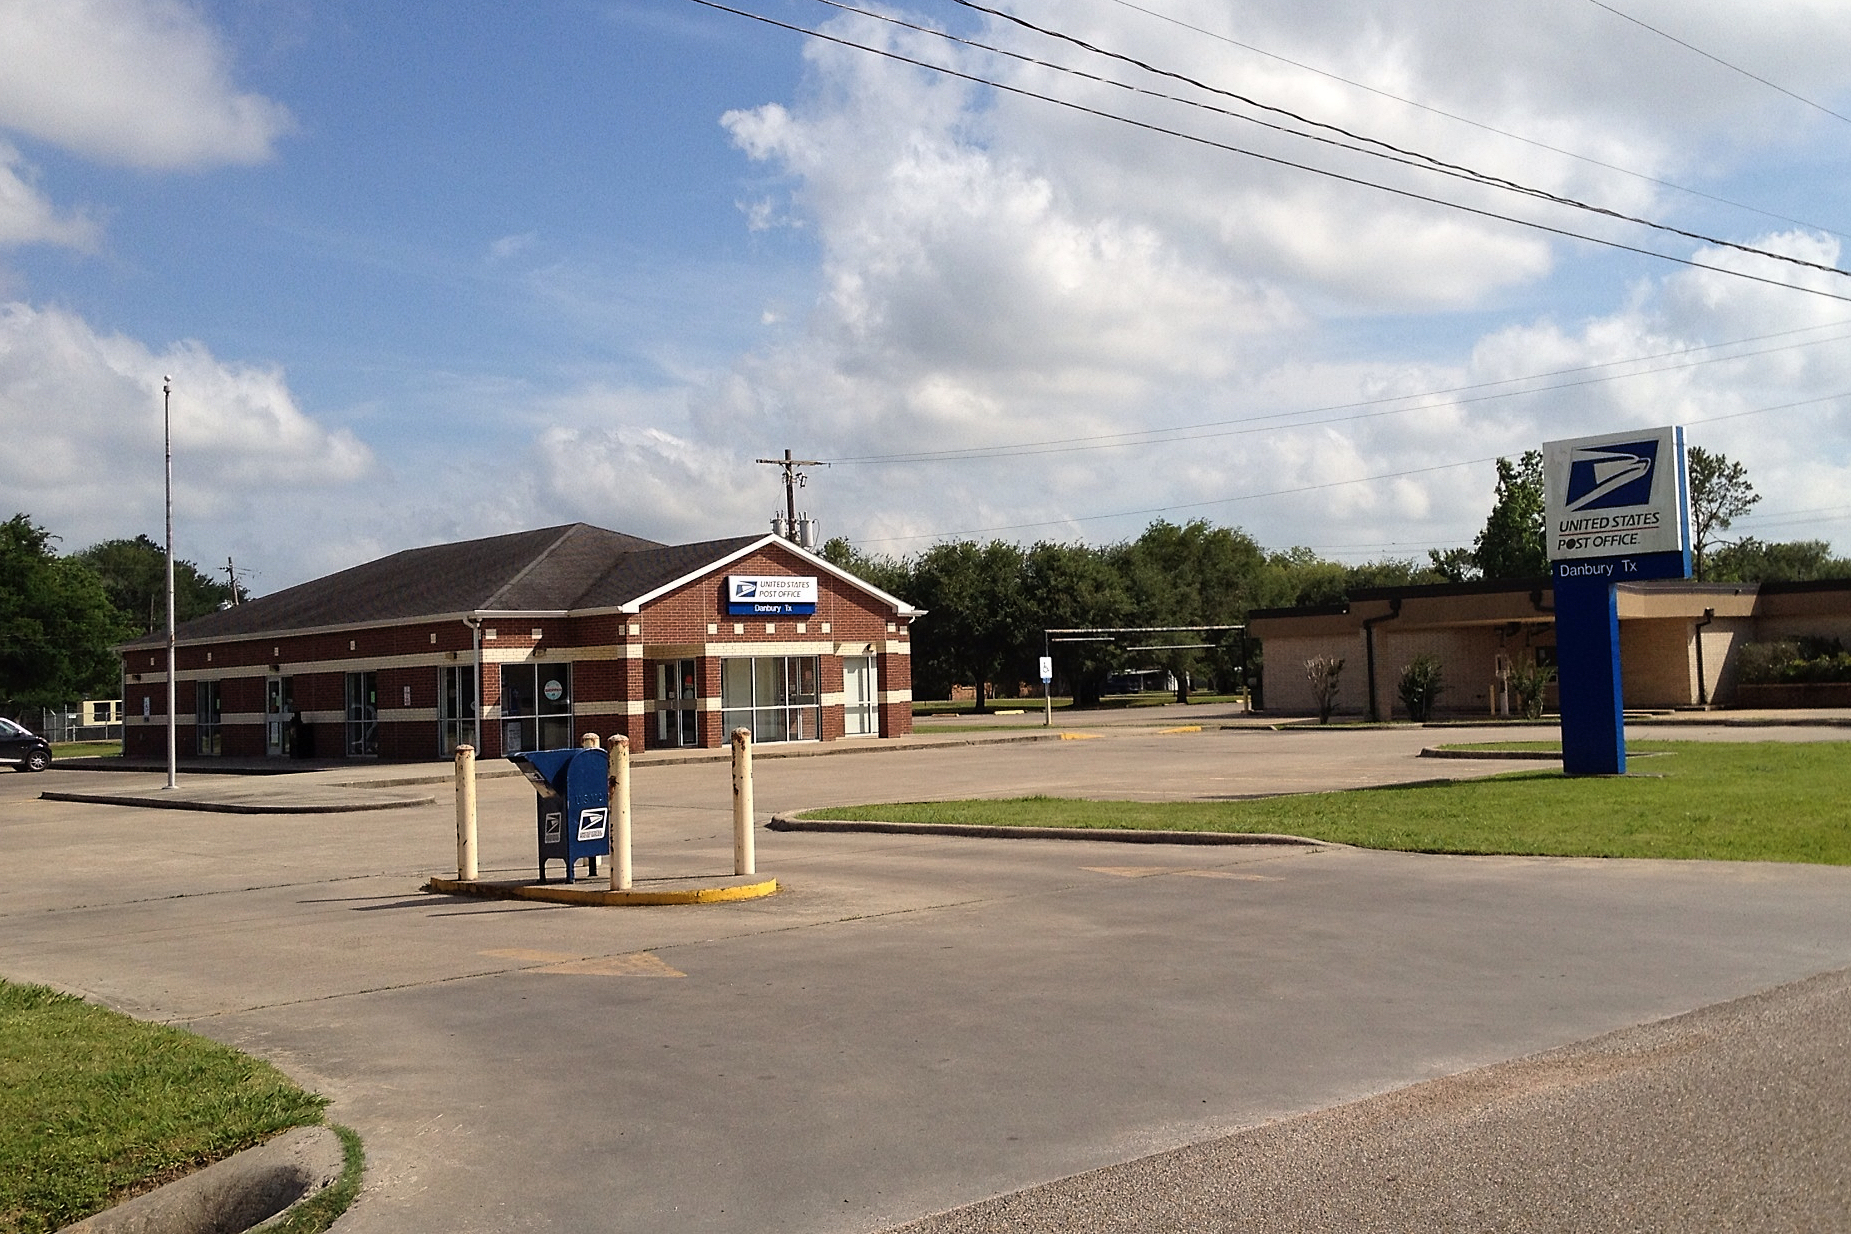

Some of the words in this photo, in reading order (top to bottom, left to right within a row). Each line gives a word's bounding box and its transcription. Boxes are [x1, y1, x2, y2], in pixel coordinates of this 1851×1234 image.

[1559, 517, 1610, 532] UNITED
[1611, 512, 1660, 528] STATES
[1593, 533, 1639, 547] OFFICE
[1560, 563, 1614, 577] Danbury
[1622, 560, 1637, 572] Tx
[754, 604, 781, 613] Danbury
